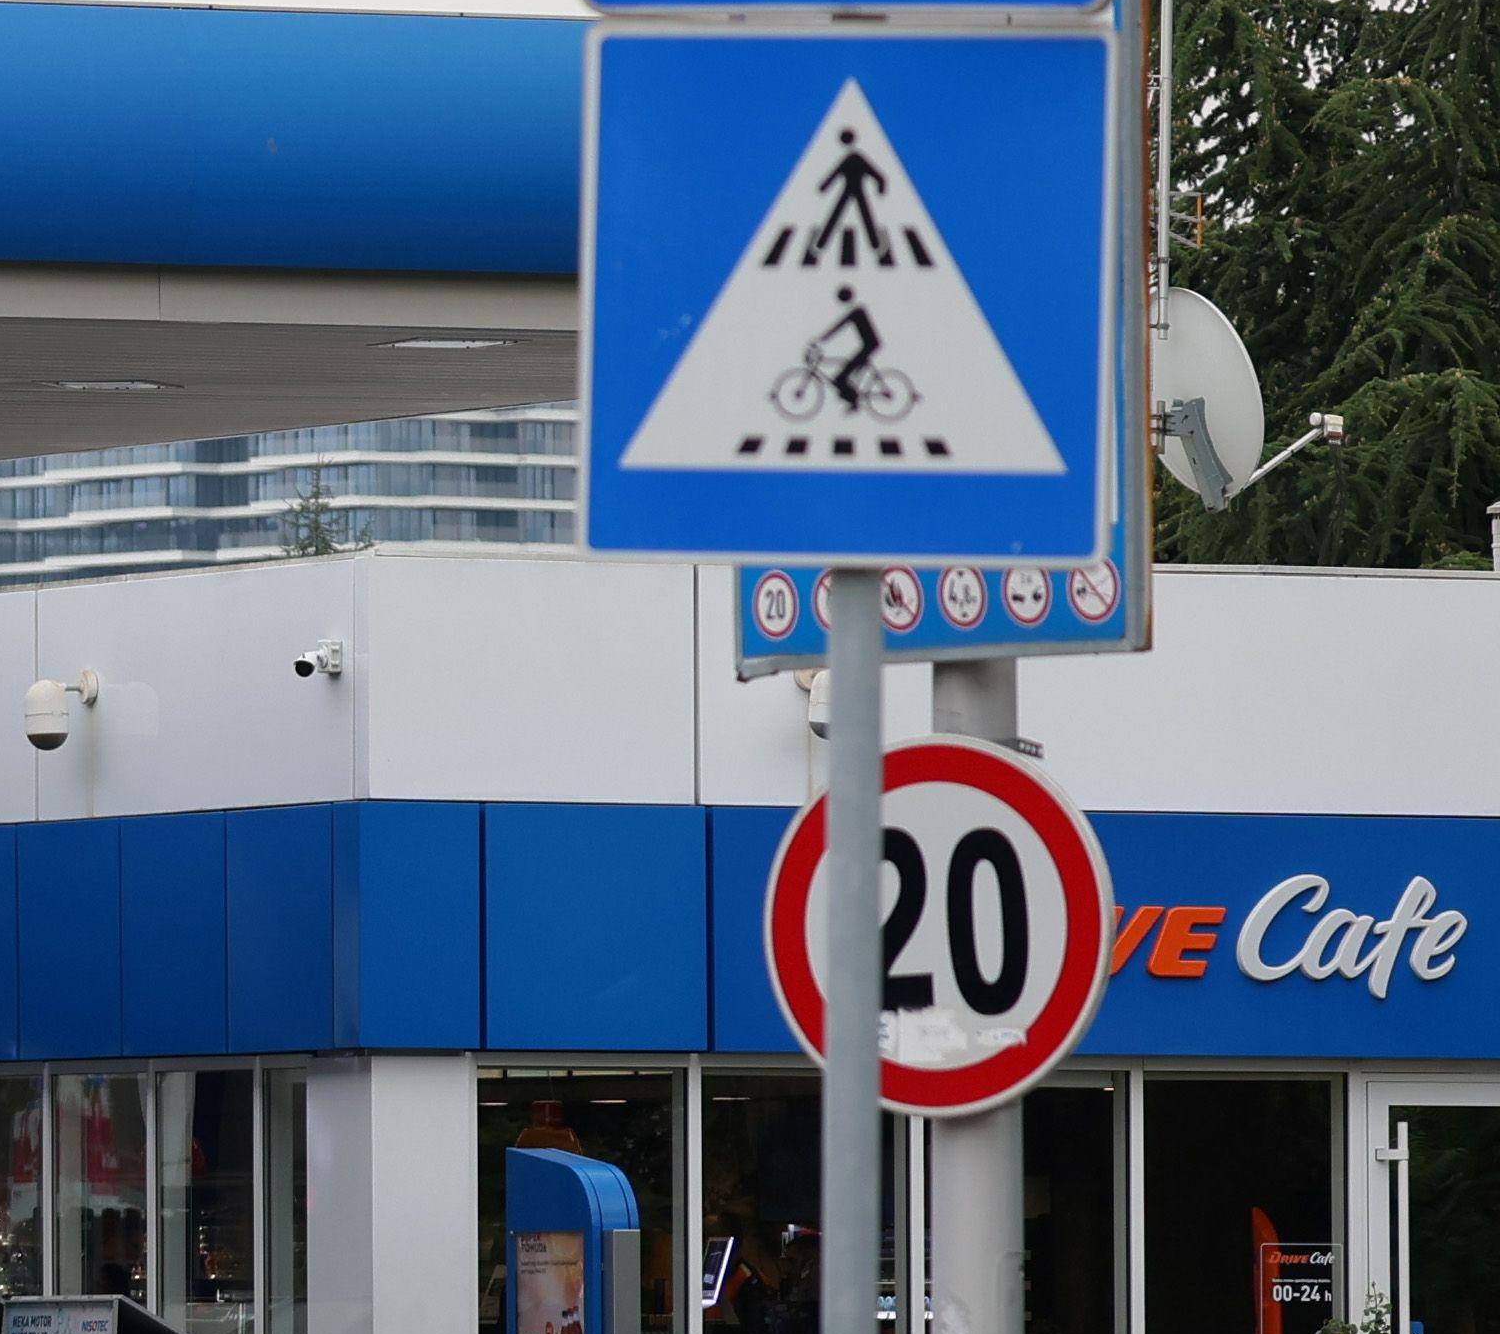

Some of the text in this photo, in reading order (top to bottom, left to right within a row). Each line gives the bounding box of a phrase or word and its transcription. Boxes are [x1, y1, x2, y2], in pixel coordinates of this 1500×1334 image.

[766, 590, 786, 619] 20
[881, 827, 1030, 1015] 20
[1236, 874, 1467, 999] Cafe
[1268, 1252, 1309, 1265] DRIVE
[1272, 1285, 1332, 1301] 00-24 h
[31, 1316, 51, 1327] MOTOR
